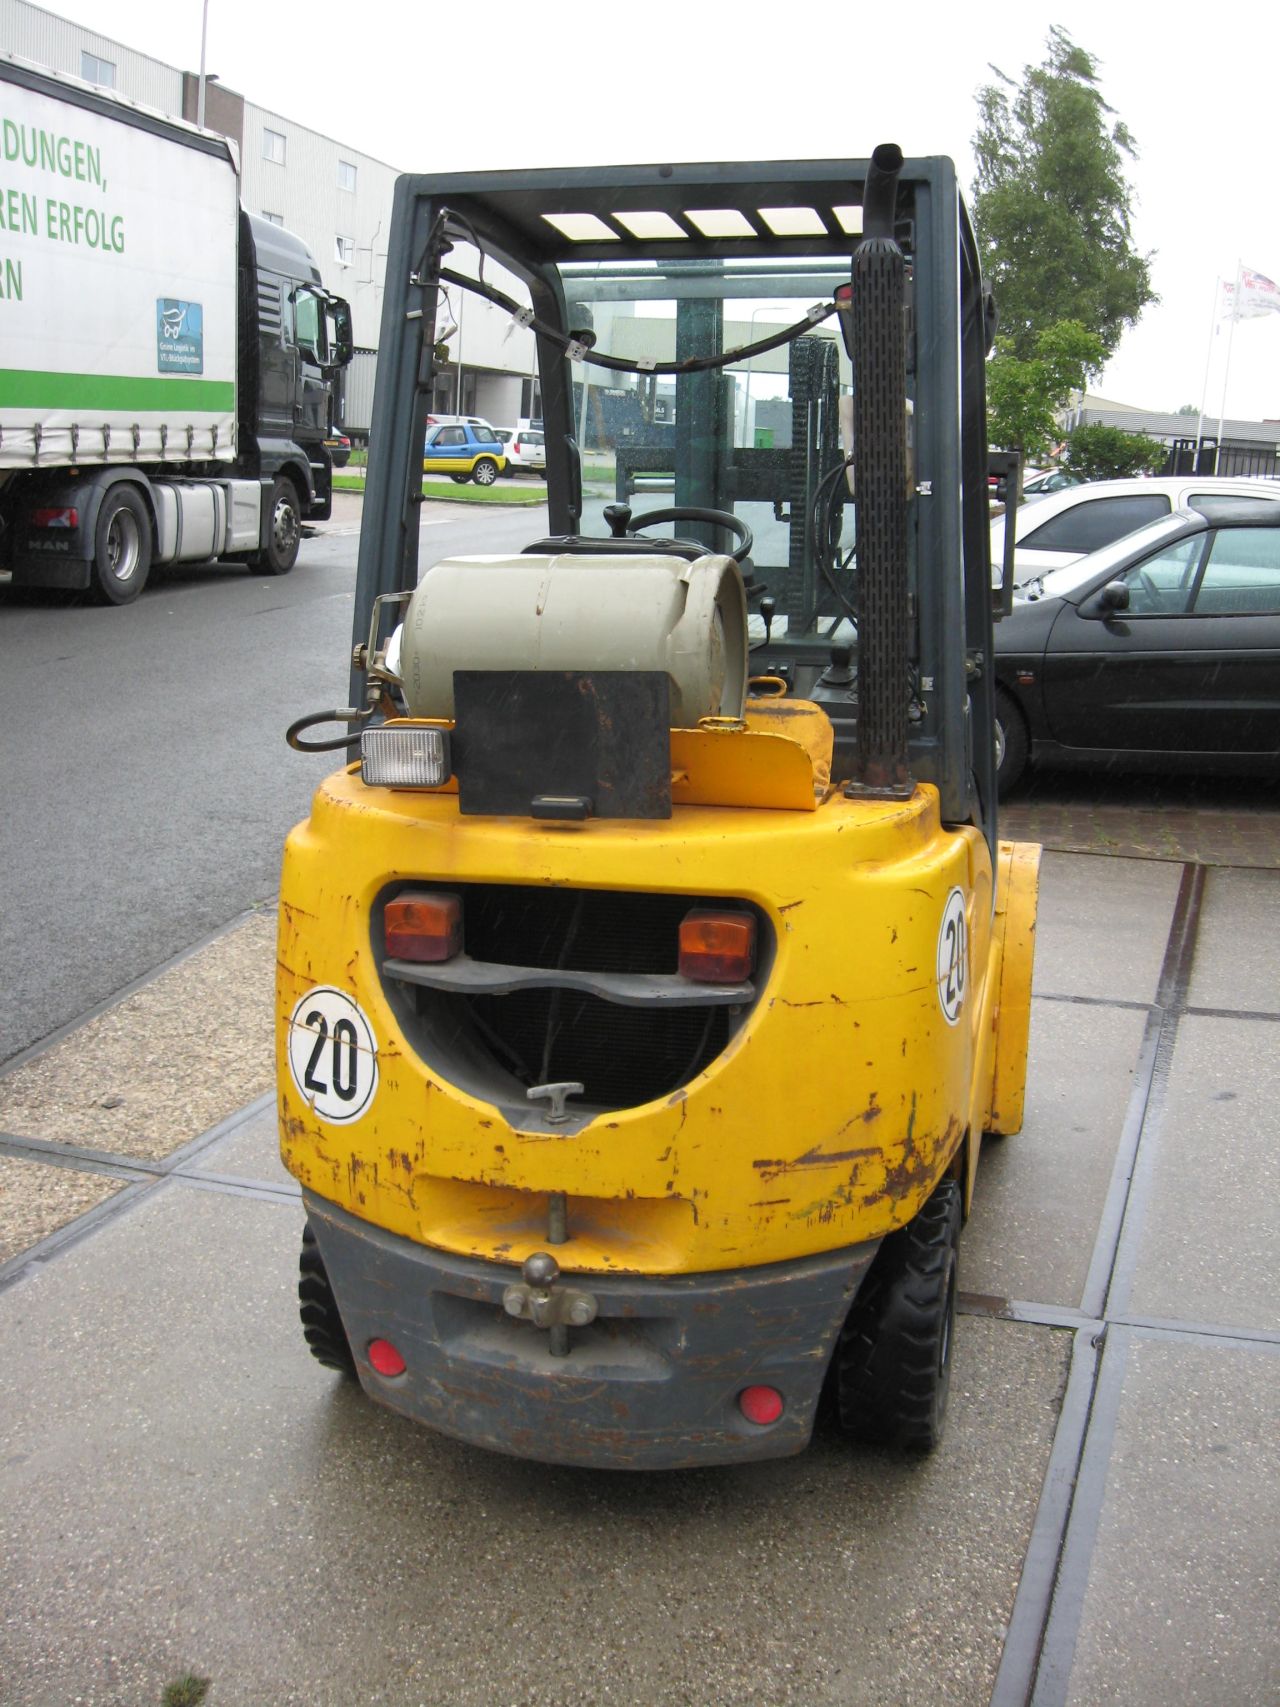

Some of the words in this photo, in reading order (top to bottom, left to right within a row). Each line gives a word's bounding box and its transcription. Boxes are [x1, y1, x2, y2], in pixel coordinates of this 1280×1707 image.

[0, 118, 107, 193] DUNGEN,
[47, 198, 125, 254] ERFOLG
[28, 540, 69, 551] MAN
[945, 910, 965, 1005] 20
[304, 1010, 358, 1102] 20
